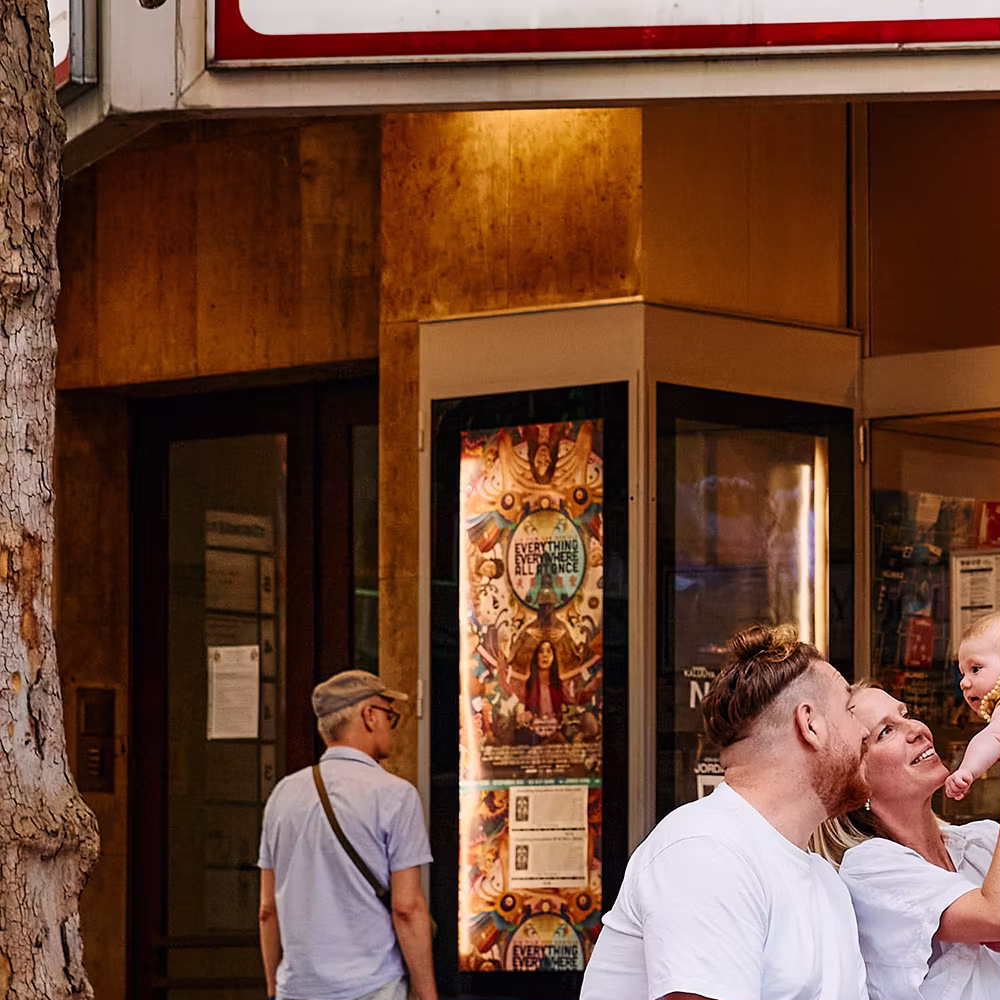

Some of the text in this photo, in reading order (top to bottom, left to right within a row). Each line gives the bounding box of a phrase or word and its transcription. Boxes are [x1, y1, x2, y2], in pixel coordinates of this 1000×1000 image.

[515, 540, 578, 553] EVERYTHING
[515, 565, 534, 576] ALL
[551, 562, 579, 574] ONCE
[513, 944, 578, 957] EVERYTHING
[513, 956, 578, 970] EVERYHERE
